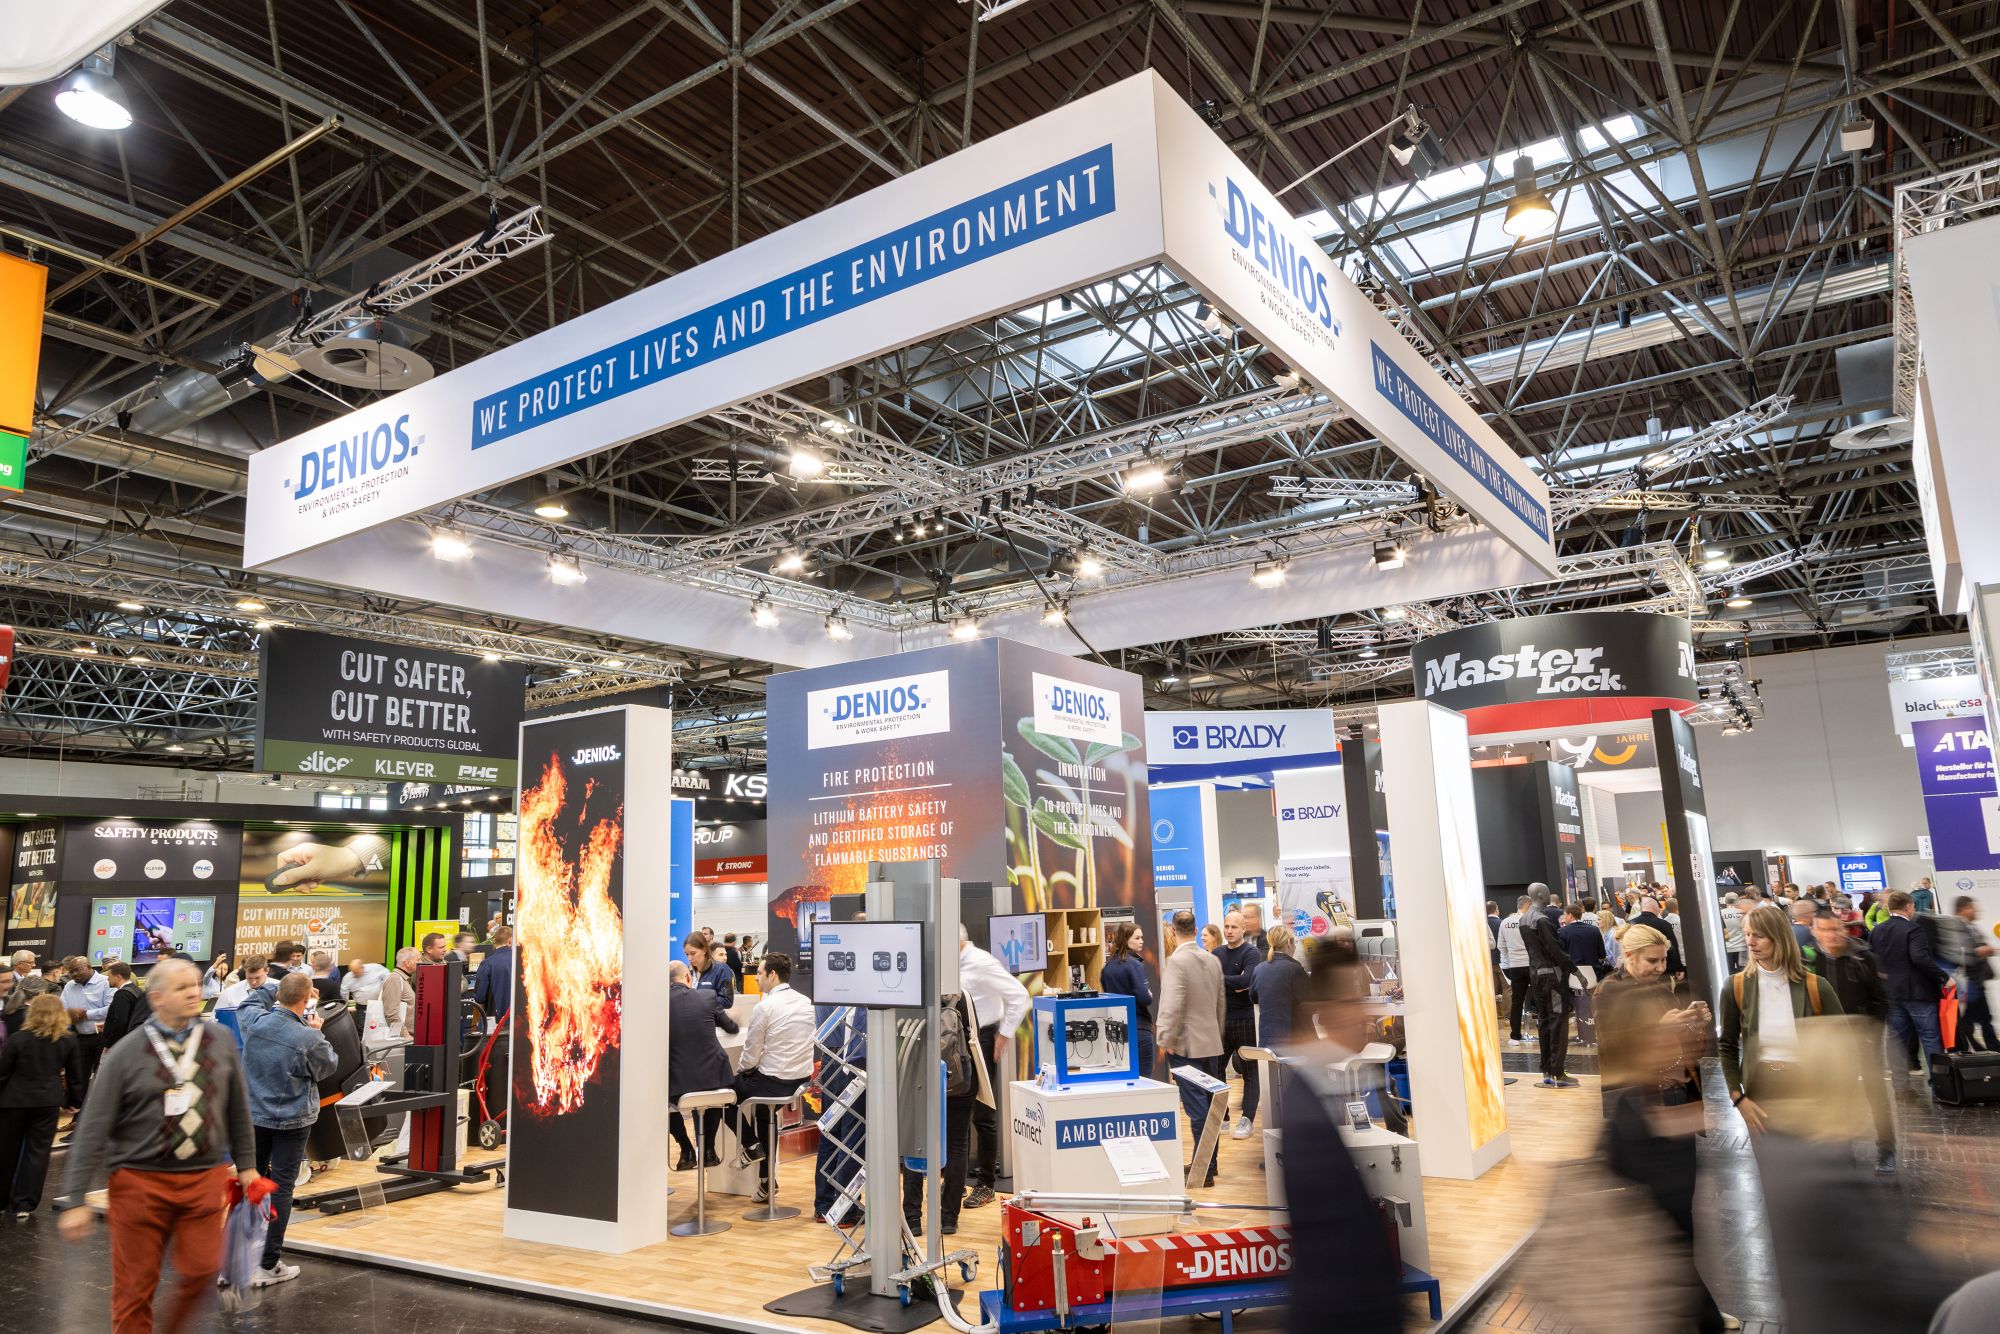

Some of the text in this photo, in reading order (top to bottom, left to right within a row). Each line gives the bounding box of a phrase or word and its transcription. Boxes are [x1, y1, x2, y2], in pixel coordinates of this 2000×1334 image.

[480, 164, 1100, 436] WE PROTECT LIVES AND THE ENVIRONMENT
[1232, 247, 1335, 351] ENVIRONMENTAL PROTECTION
[1260, 292, 1315, 348] & WORK SAFETY
[1375, 355, 1548, 536] WE PROTECT LIVES AND THE ENVIRONMENT
[298, 466, 409, 514] ENVIRONMENTAL PROTECTION
[322, 490, 381, 518] & WORK SAFETY
[341, 650, 472, 699] CUT SAFER,
[1425, 644, 1603, 696] Master
[331, 689, 477, 734] CUT BETTER.
[836, 713, 921, 730] ENVIRONMENTAL PROTECTION
[322, 728, 482, 751] WITH SAFETY PRODUCTS GLOBAL
[861, 726, 878, 734] WORK
[879, 723, 900, 732] SAFETY
[1616, 733, 1649, 744] JAHRE
[458, 765, 498, 779] PHC
[823, 760, 934, 788] FIRE PROTECTION
[1058, 761, 1107, 782] INNOVATION
[1936, 763, 1973, 772] Hersteller
[1974, 761, 1986, 770] für
[1937, 772, 1985, 781] Manufacturer
[1555, 785, 1577, 808] Master
[813, 800, 946, 826] LITHIUM BATTERY SAFETY
[1044, 800, 1054, 813] TO
[1056, 801, 1087, 817] PROTECT
[1109, 807, 1122, 818] AND
[1298, 805, 1342, 820] BRADY
[22, 831, 36, 848] CUT
[94, 826, 218, 840] SAFETY PRODUCTS
[808, 821, 953, 846] AND CERTIFIED STORAGE OF
[1054, 821, 1116, 837] THE ENVIRONMENT
[18, 848, 56, 867] CUT BETTER.
[815, 843, 947, 866] FLAMMABLE SUBSTANCES
[243, 906, 343, 921] CUT WITH PRECISION.
[263, 924, 288, 937] WITH
[1025, 1107, 1037, 1122] DENIOS
[1013, 1117, 1042, 1145] connect
